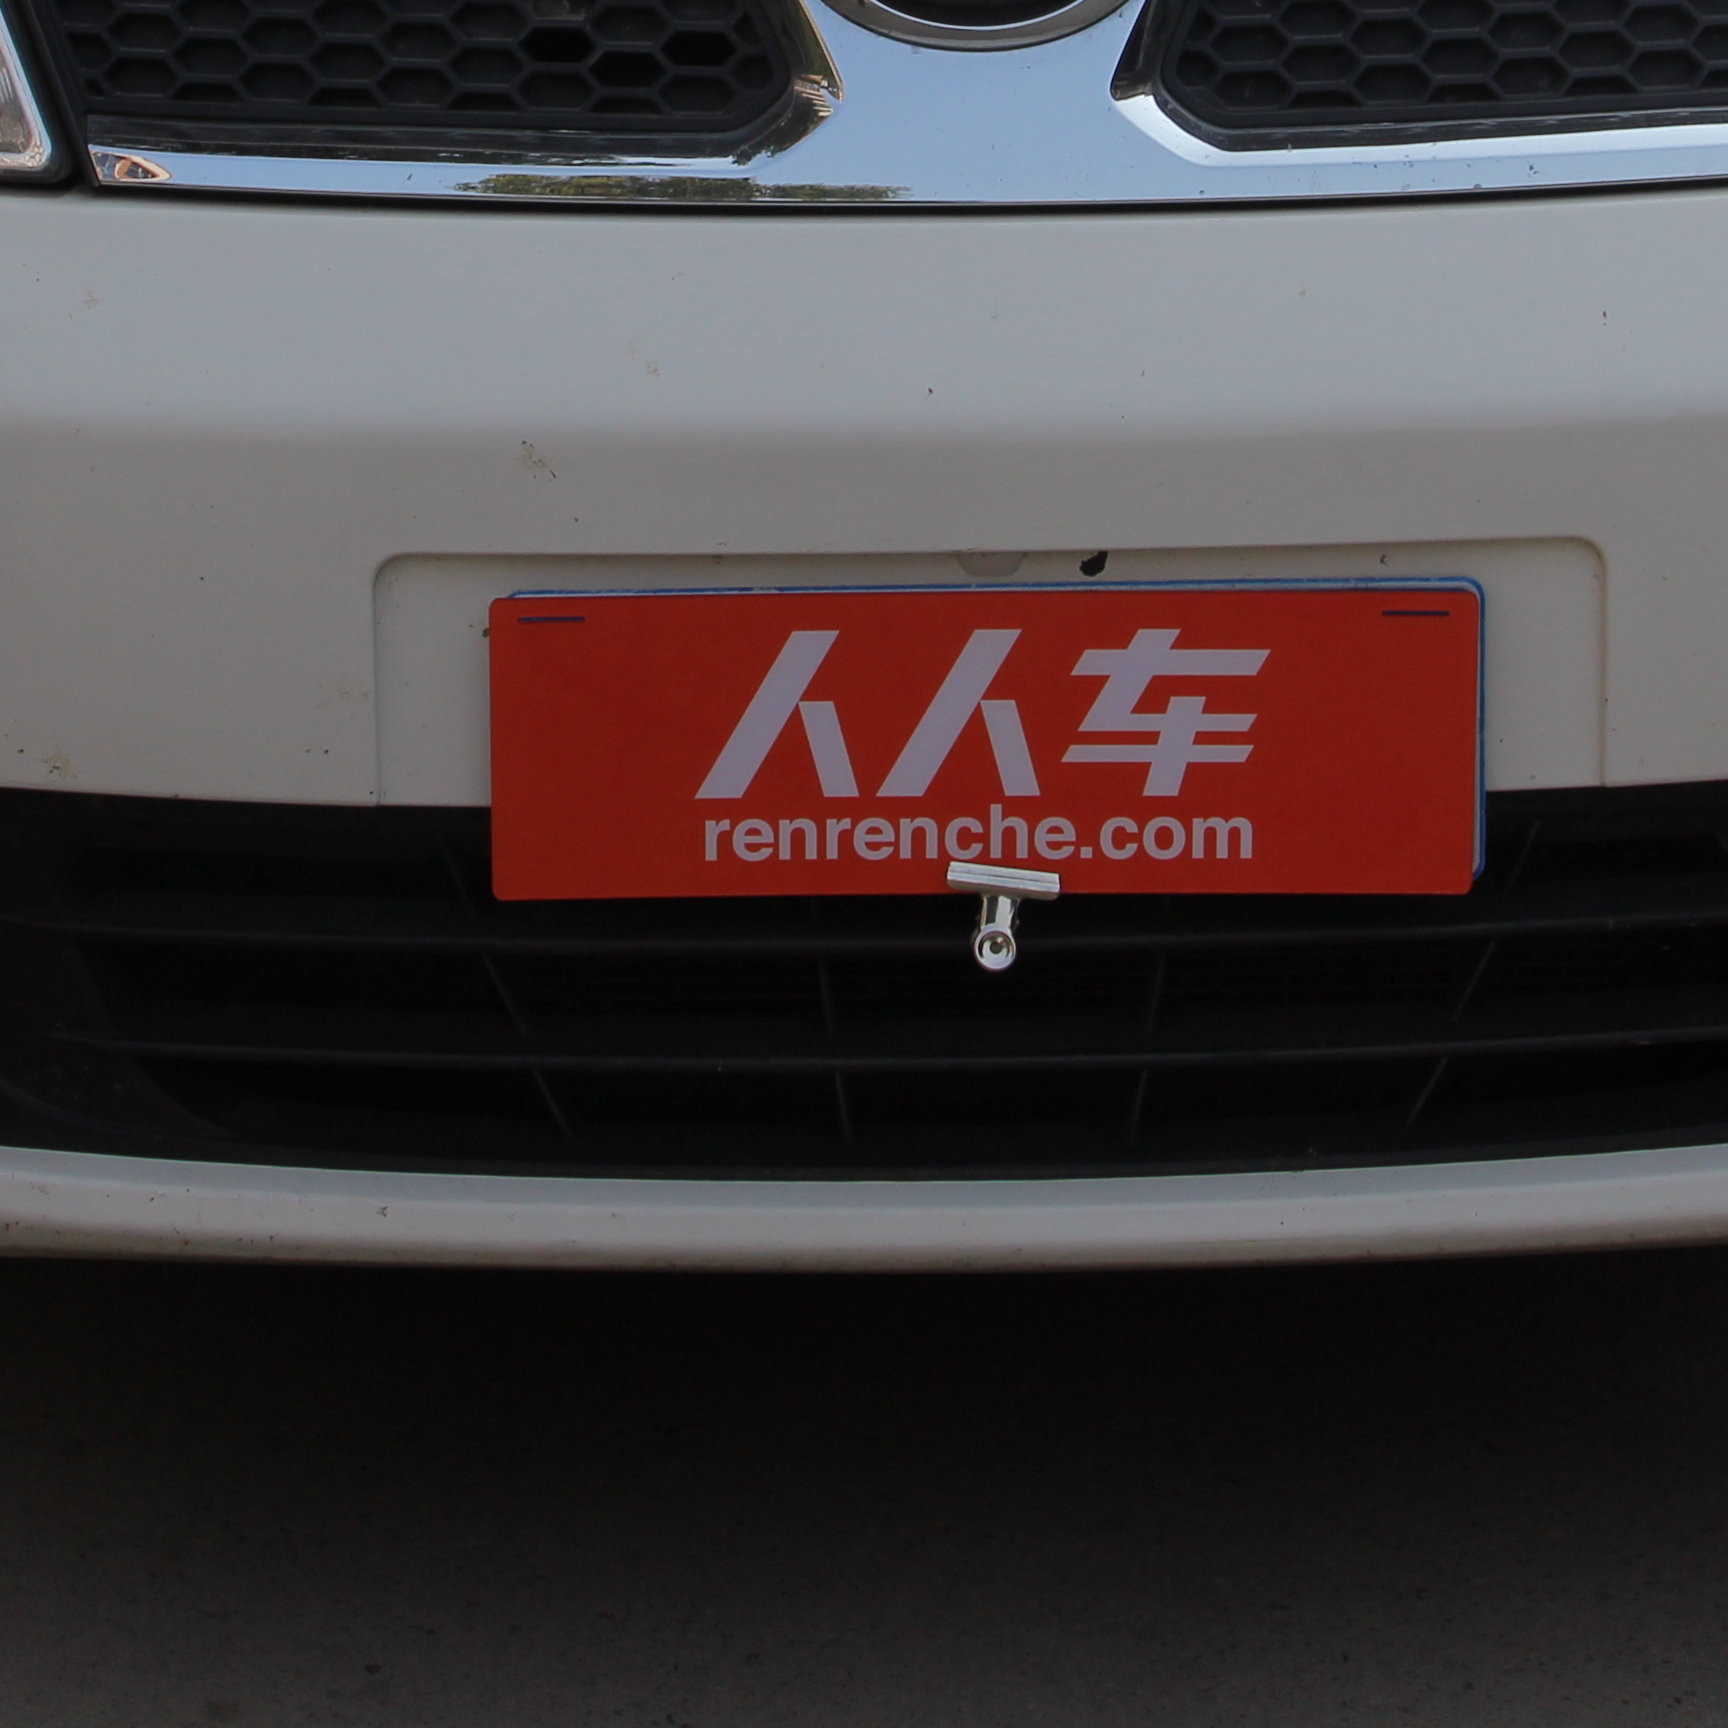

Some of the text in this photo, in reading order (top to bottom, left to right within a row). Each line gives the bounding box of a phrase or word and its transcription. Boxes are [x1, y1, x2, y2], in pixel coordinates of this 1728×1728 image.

[693, 627, 1272, 799] 人人车
[704, 803, 1254, 863] renrenche.com
